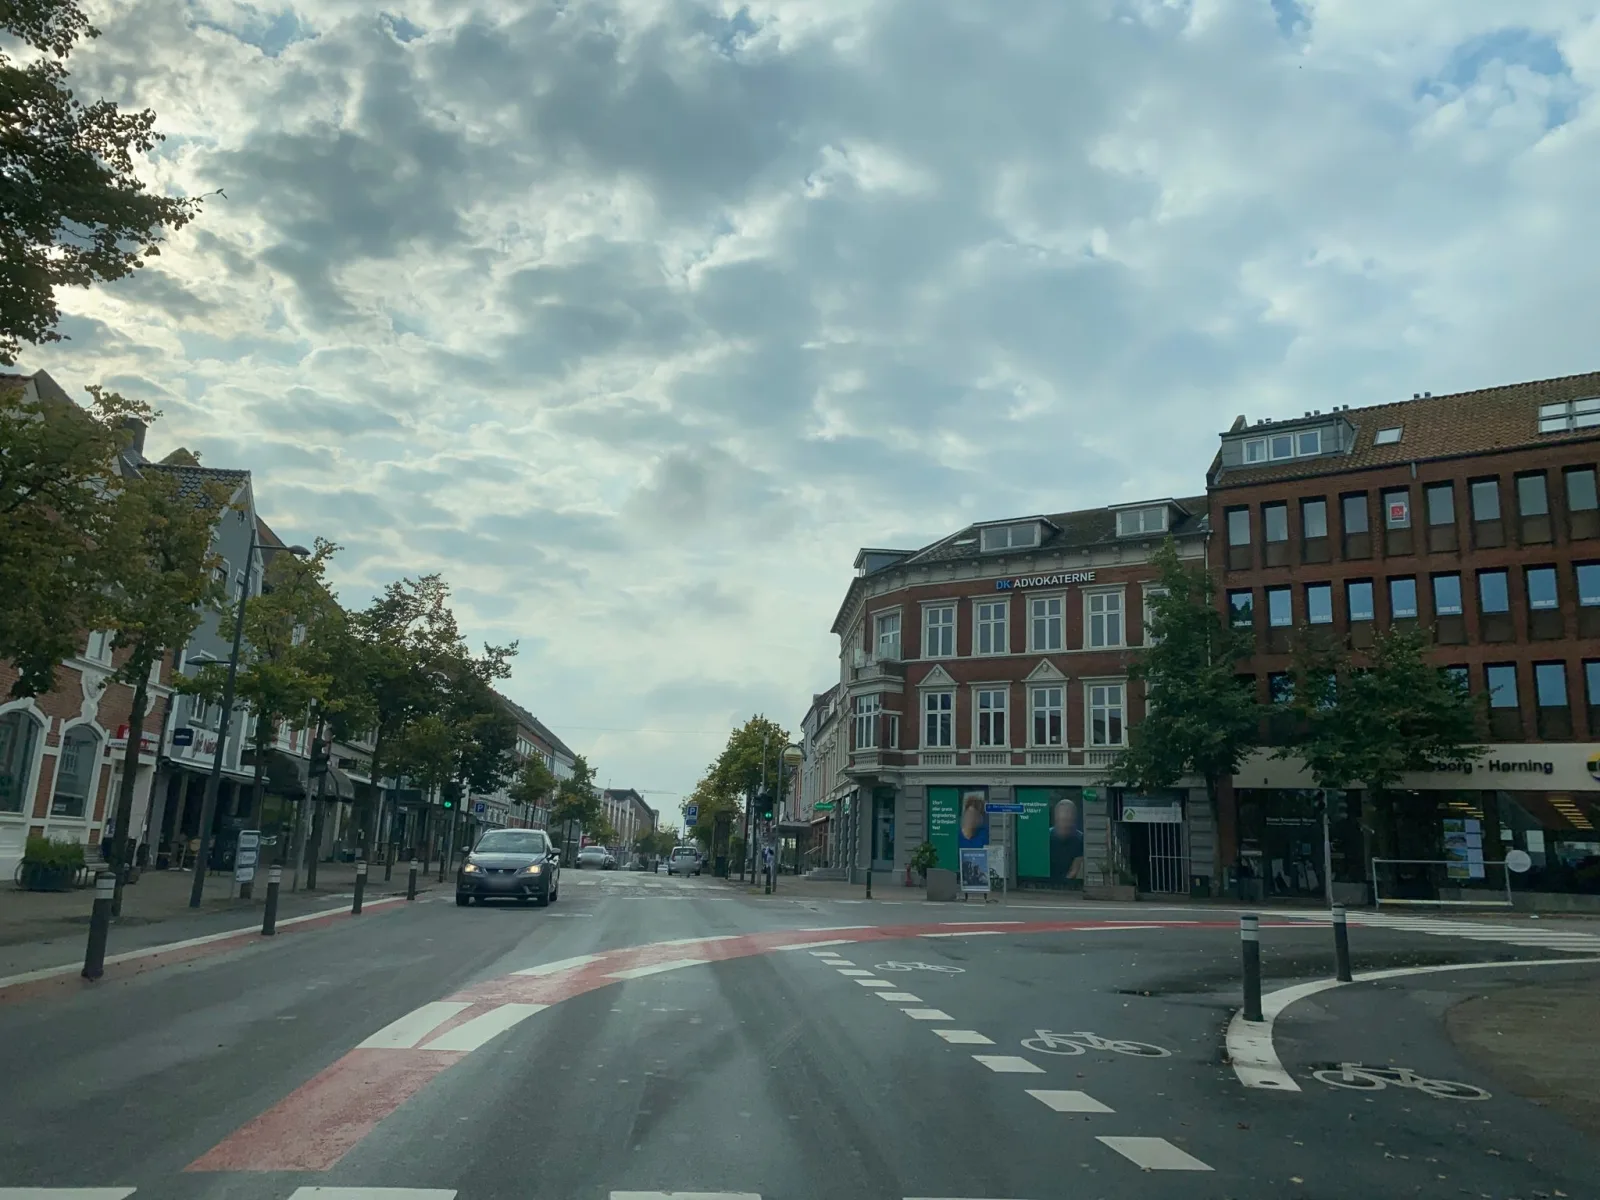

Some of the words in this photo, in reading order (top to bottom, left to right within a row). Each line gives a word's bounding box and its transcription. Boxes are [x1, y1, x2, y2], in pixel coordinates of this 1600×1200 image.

[995, 580, 1011, 590] DK
[1013, 571, 1096, 588] ADVOKATERNE
[1488, 759, 1554, 774] Hørning
